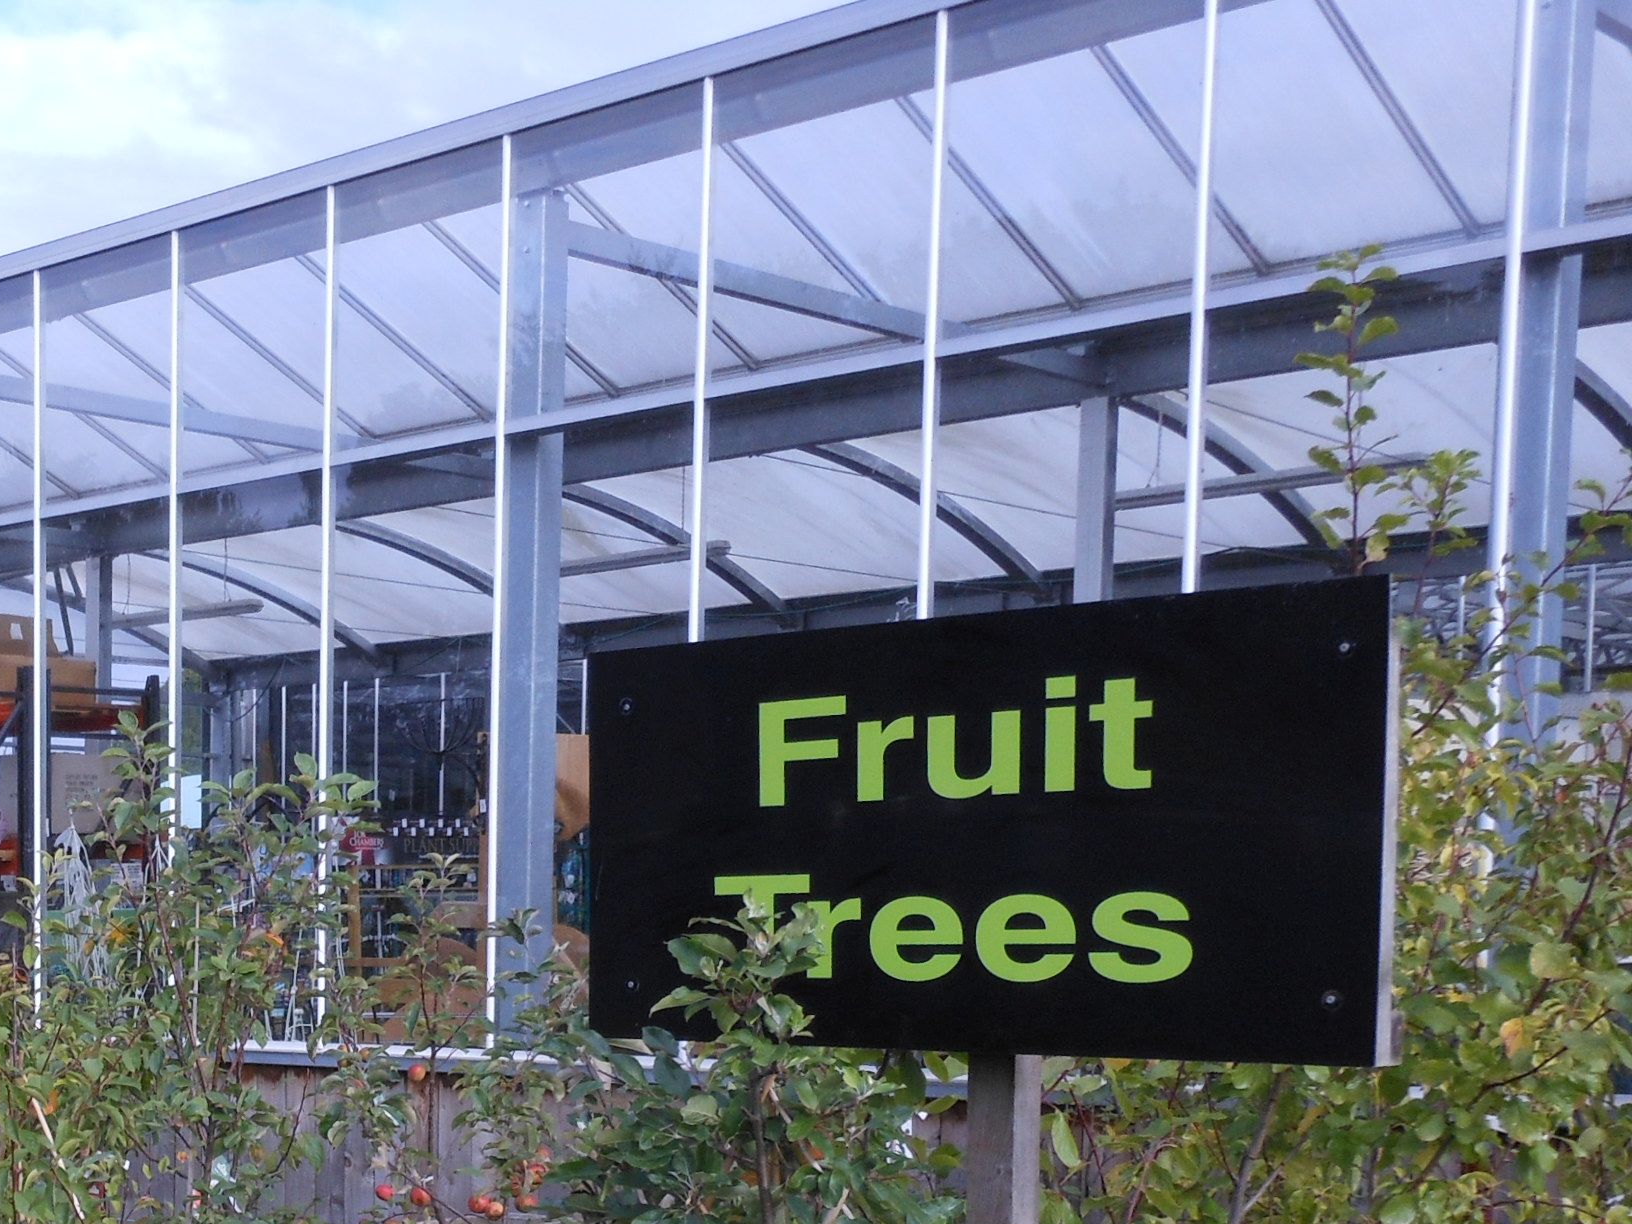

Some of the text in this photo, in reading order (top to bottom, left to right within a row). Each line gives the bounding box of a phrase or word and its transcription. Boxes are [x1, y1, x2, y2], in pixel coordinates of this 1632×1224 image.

[759, 675, 1154, 807] Fruit
[403, 838, 445, 853] PLANT
[714, 874, 1194, 983] Trees
